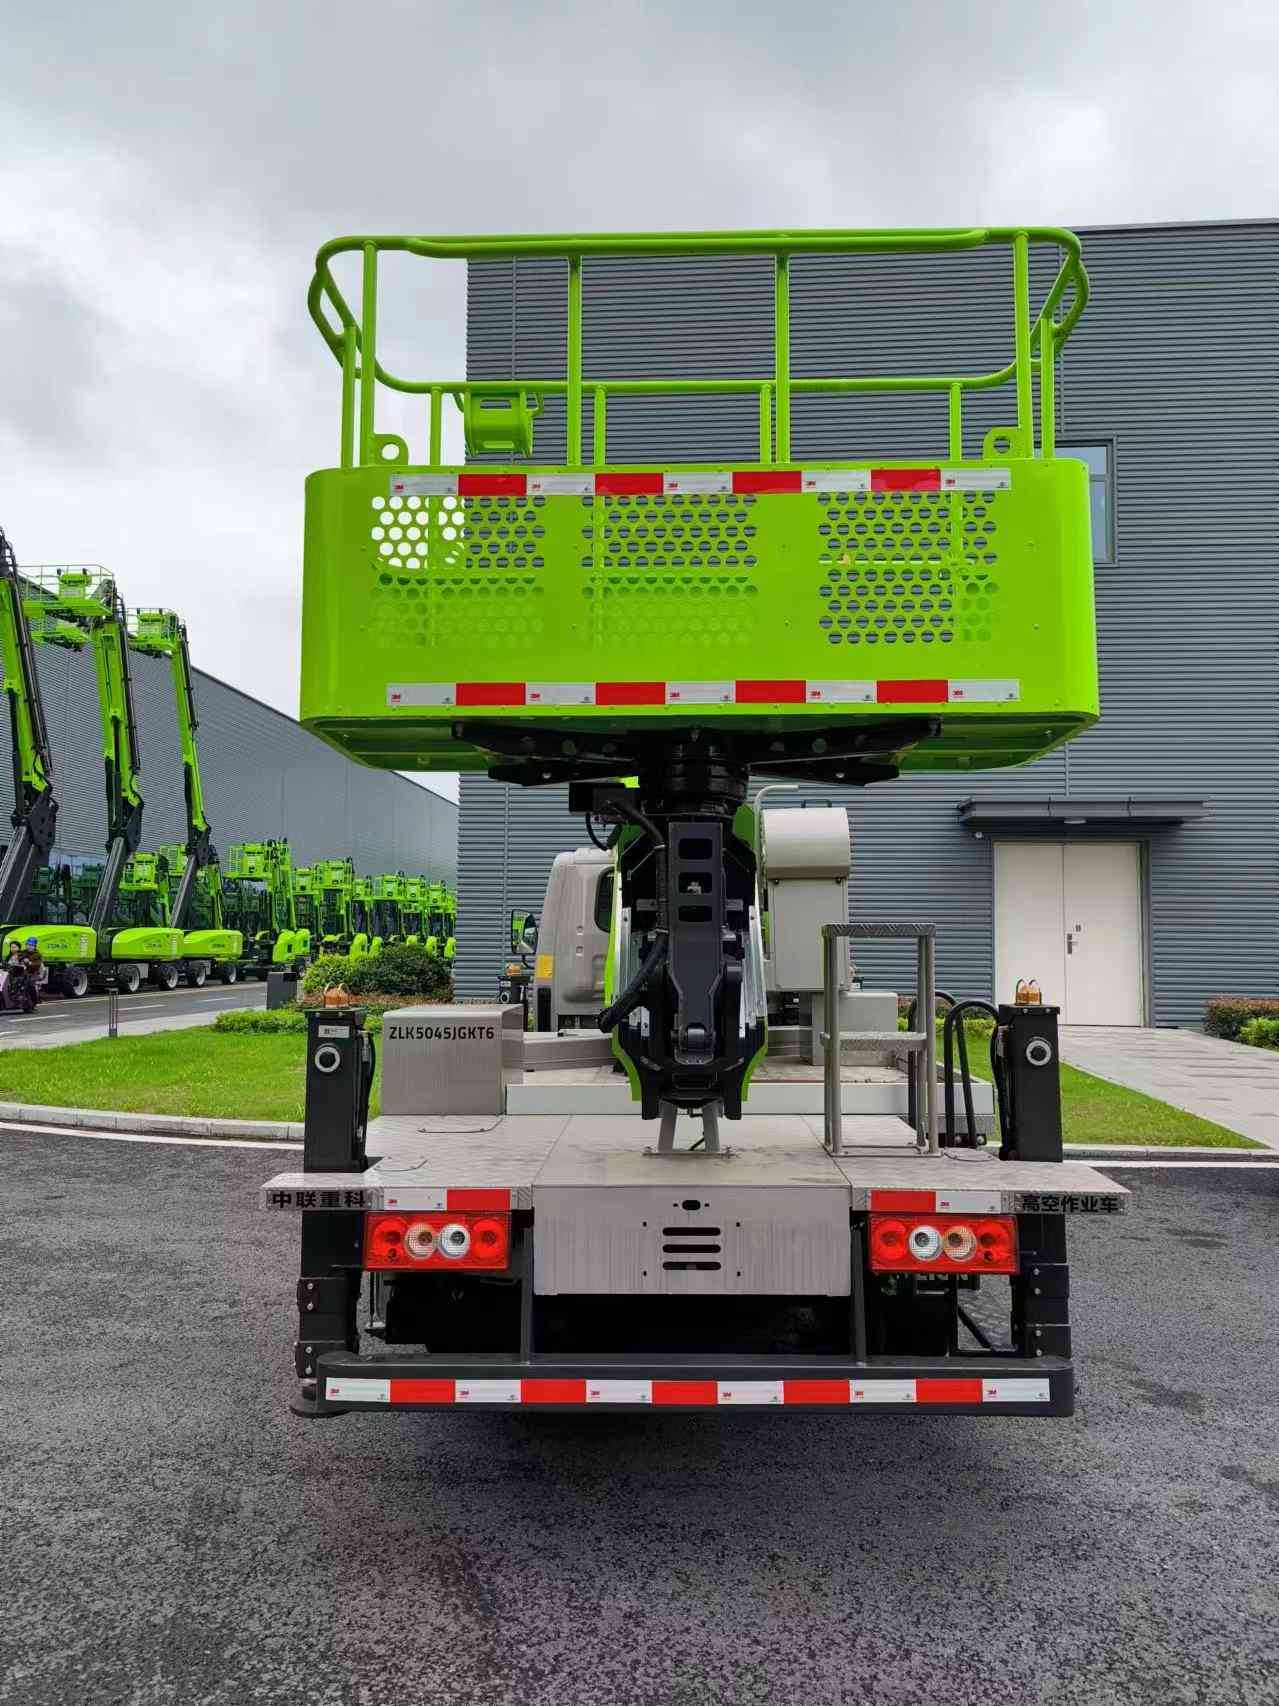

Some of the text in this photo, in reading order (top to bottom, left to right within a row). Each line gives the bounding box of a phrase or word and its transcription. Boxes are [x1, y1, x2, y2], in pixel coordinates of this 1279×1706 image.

[389, 1026, 495, 1040] ZLK5045JGKT6
[272, 1190, 366, 1208] 中联重科
[1022, 1195, 1118, 1213] 高空作业车
